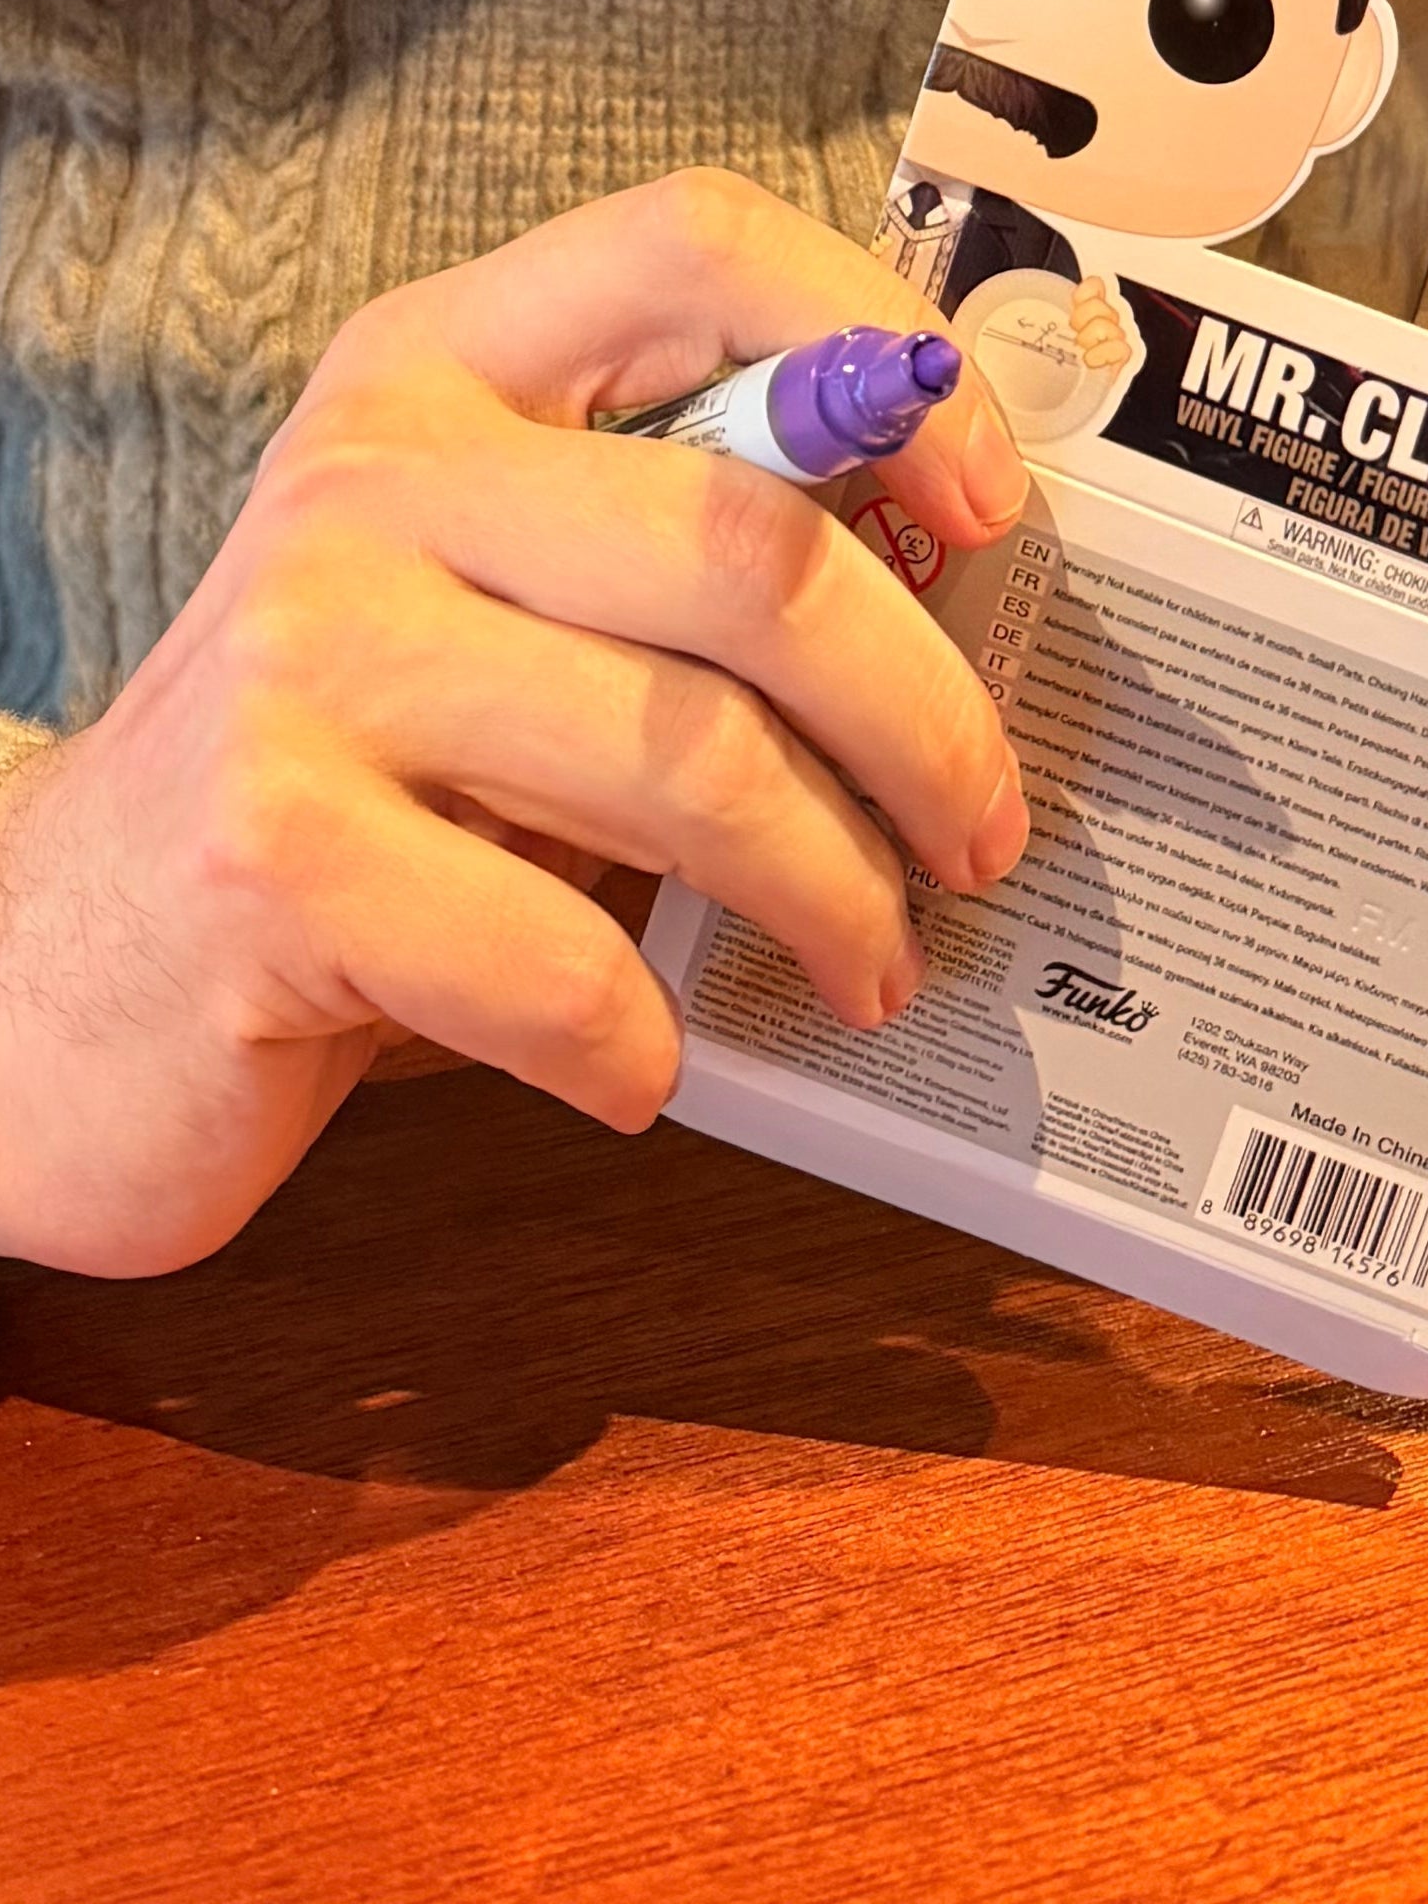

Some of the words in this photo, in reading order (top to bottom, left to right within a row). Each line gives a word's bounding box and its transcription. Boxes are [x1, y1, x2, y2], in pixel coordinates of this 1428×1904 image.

[1180, 314, 1327, 441] MR.
[1175, 393, 1243, 447] VINYL
[1248, 423, 1340, 483] FIGURE
[1285, 475, 1375, 536] FIGURA
[1378, 512, 1417, 550] DE
[1019, 538, 1051, 563] EN
[1263, 537, 1297, 560] Small
[1292, 550, 1326, 575] parts.
[1327, 560, 1348, 579] Not
[1347, 568, 1364, 585] for
[1363, 577, 1406, 603] children
[1282, 517, 1380, 574] WARNING:
[1001, 594, 1031, 618] ES
[1010, 566, 1041, 591] FR
[986, 651, 1010, 671] IT
[991, 622, 1023, 647] DE
[1033, 960, 1152, 1033] Funko
[1040, 1002, 1133, 1044] www.funko.com
[1176, 1046, 1210, 1070] (425)
[1181, 1030, 1231, 1061] Everett,
[1234, 1049, 1257, 1069] WA
[1259, 1059, 1301, 1085] 98203
[1189, 1015, 1222, 1038] 1202
[1222, 1028, 1279, 1059] Shuksan
[1281, 1049, 1310, 1073] Way
[1289, 1101, 1347, 1137] Made
[1351, 1124, 1371, 1147] In
[1199, 1198, 1213, 1215] 8
[1242, 1211, 1317, 1255] 89698
[1331, 1245, 1400, 1288] 14576
